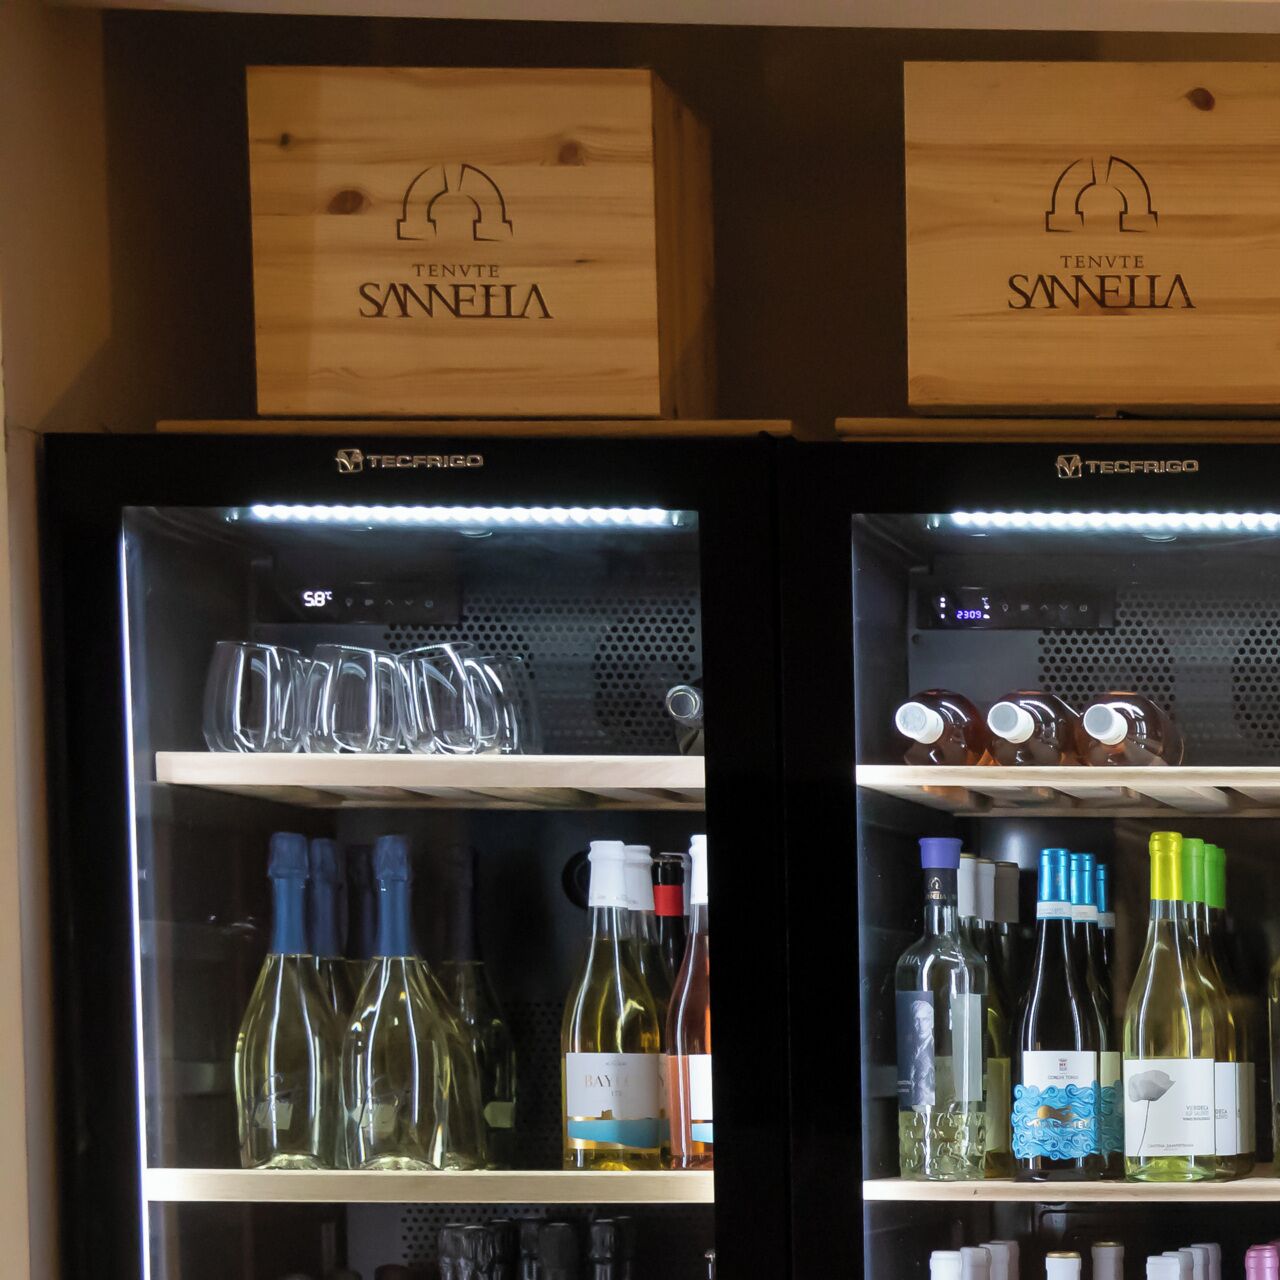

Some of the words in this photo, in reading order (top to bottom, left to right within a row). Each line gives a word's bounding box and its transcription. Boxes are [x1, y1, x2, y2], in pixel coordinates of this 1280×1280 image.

[1060, 254, 1146, 270] TENVTE
[411, 263, 500, 279] TENVTE
[1007, 273, 1198, 310] SANNELLA
[358, 281, 554, 320] SANNELLA
[366, 453, 485, 470] TECFRIGO
[1084, 459, 1200, 475] TECFRIGO
